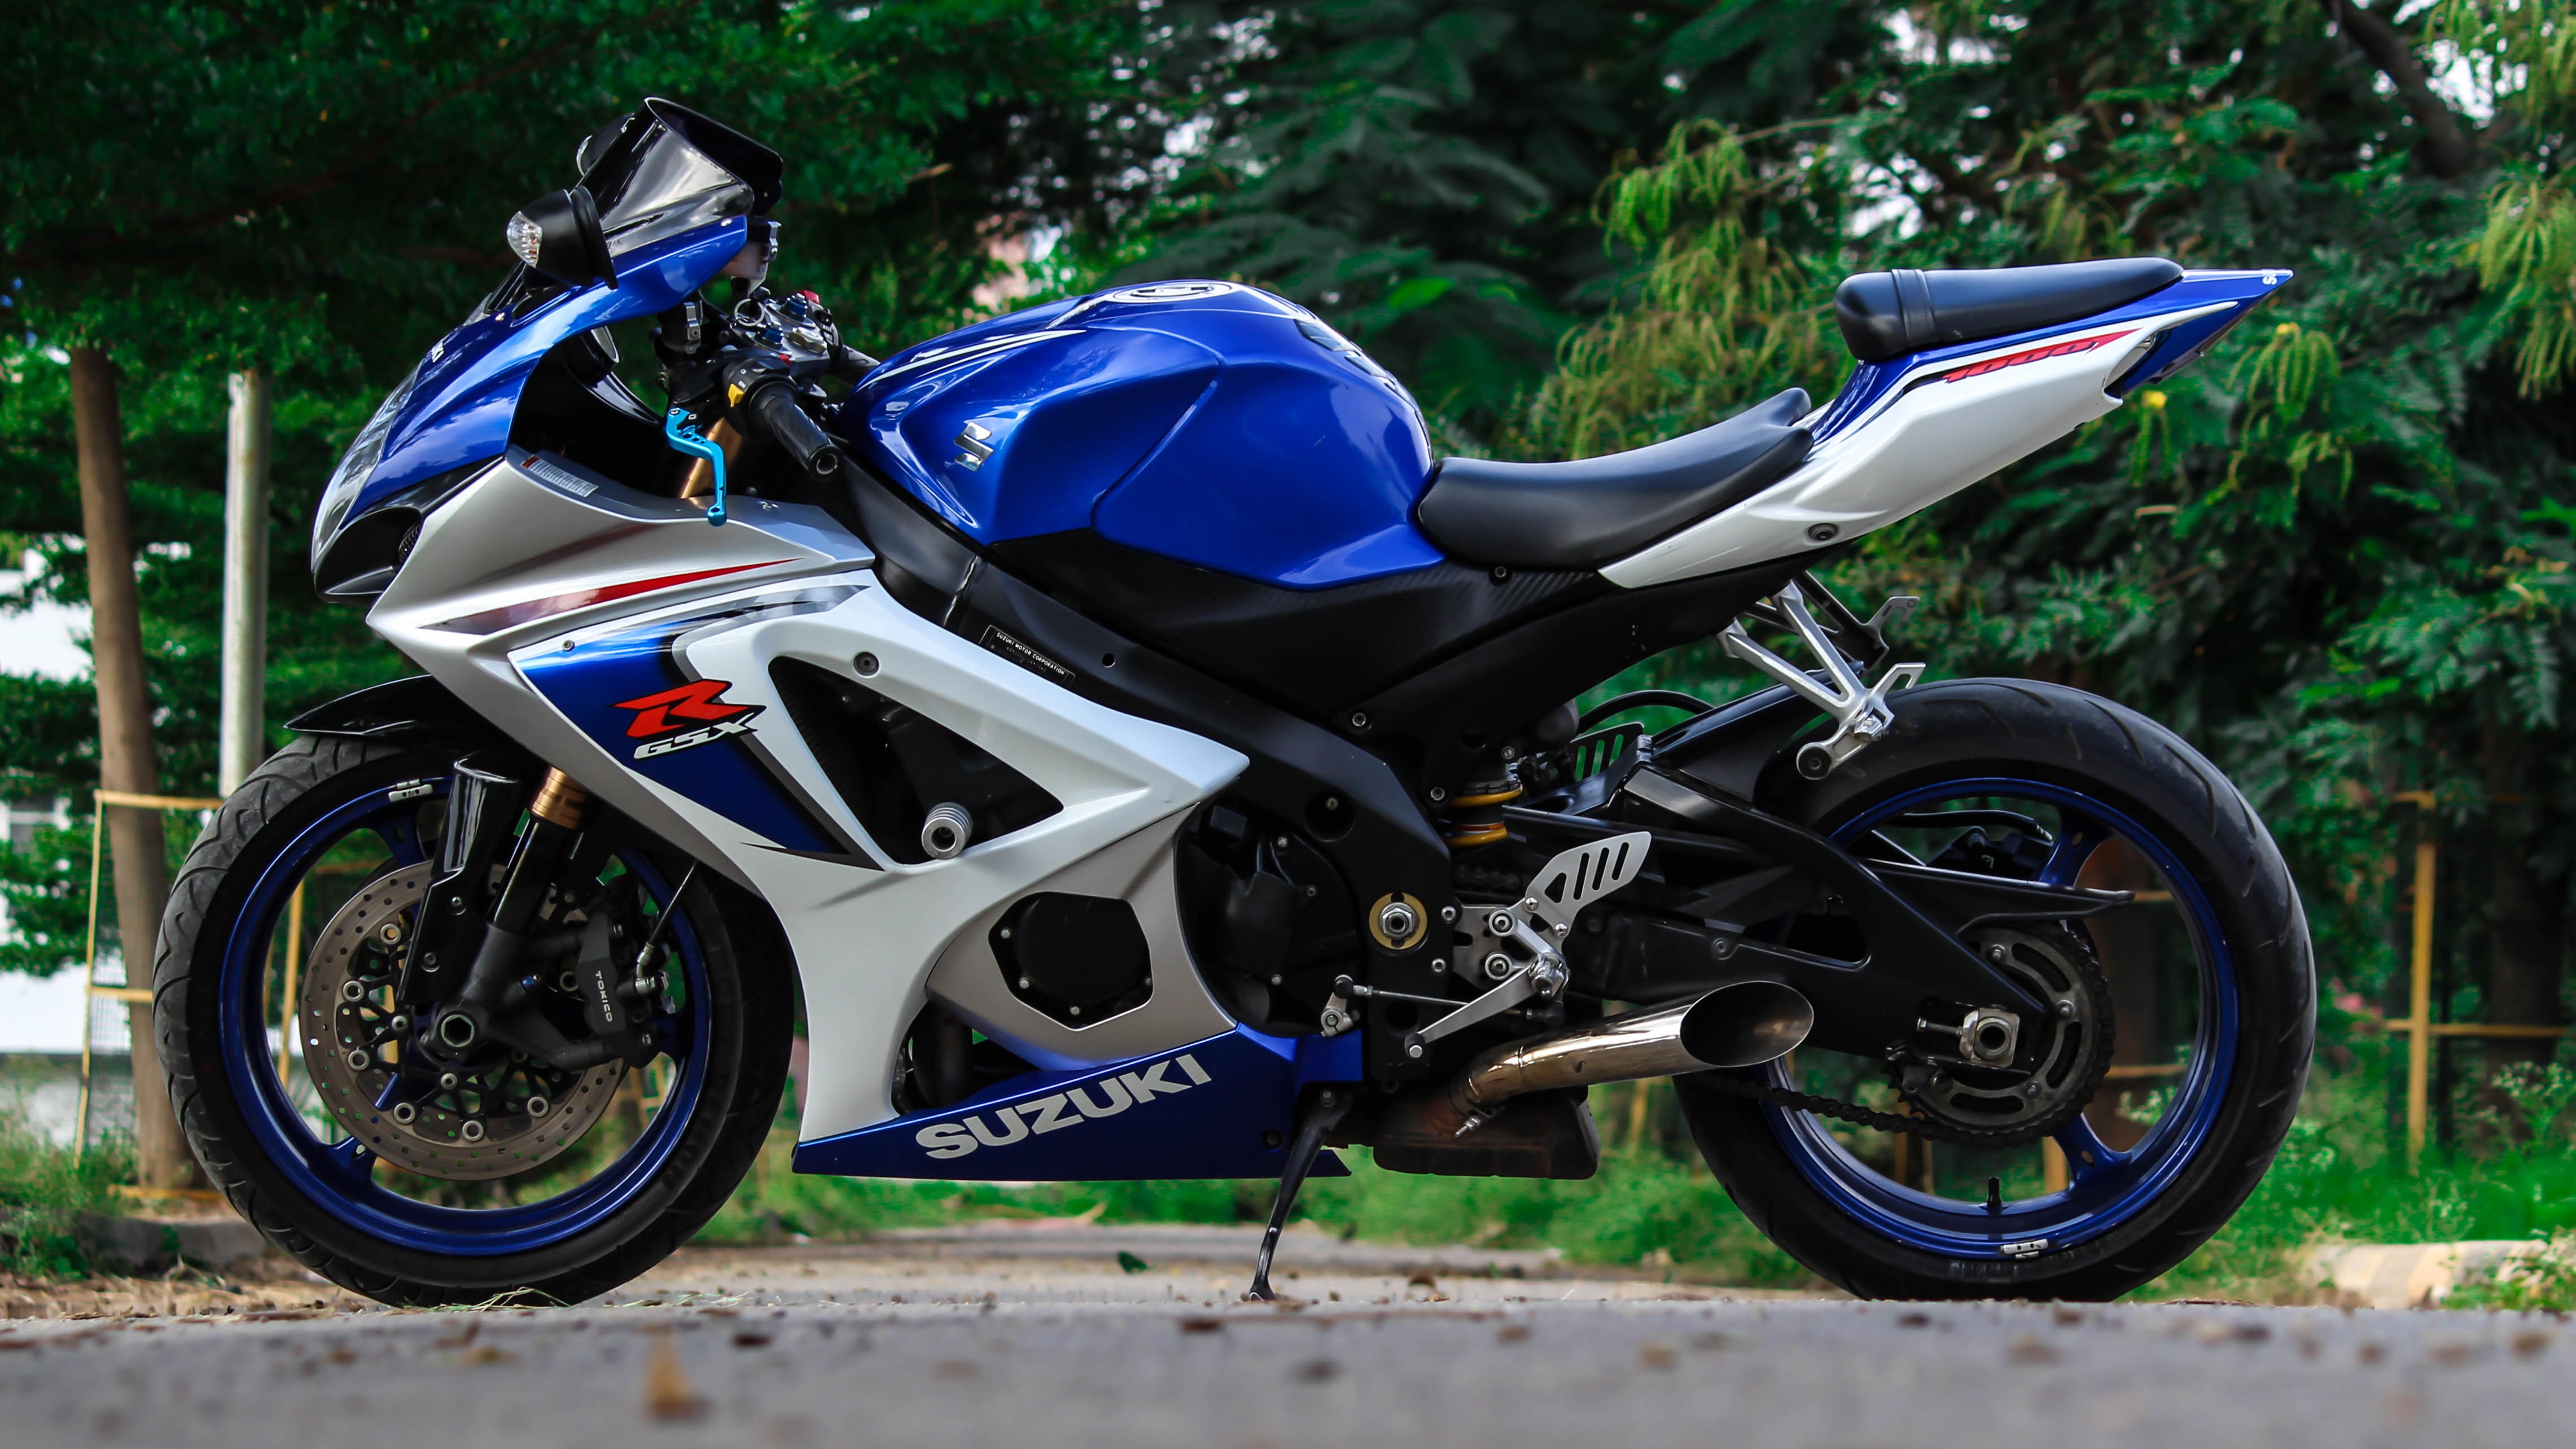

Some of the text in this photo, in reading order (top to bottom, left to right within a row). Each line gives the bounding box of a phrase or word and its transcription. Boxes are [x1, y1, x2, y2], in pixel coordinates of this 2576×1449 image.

[1942, 340, 2097, 384] 1000
[997, 632, 1014, 645] SUZUKI
[1015, 642, 1032, 655] MOTOR
[1032, 654, 1065, 675] CORPORATION
[634, 712, 755, 759] GSX
[595, 970, 613, 1022] TOKICO
[915, 1054, 1212, 1159] SUZUKI
